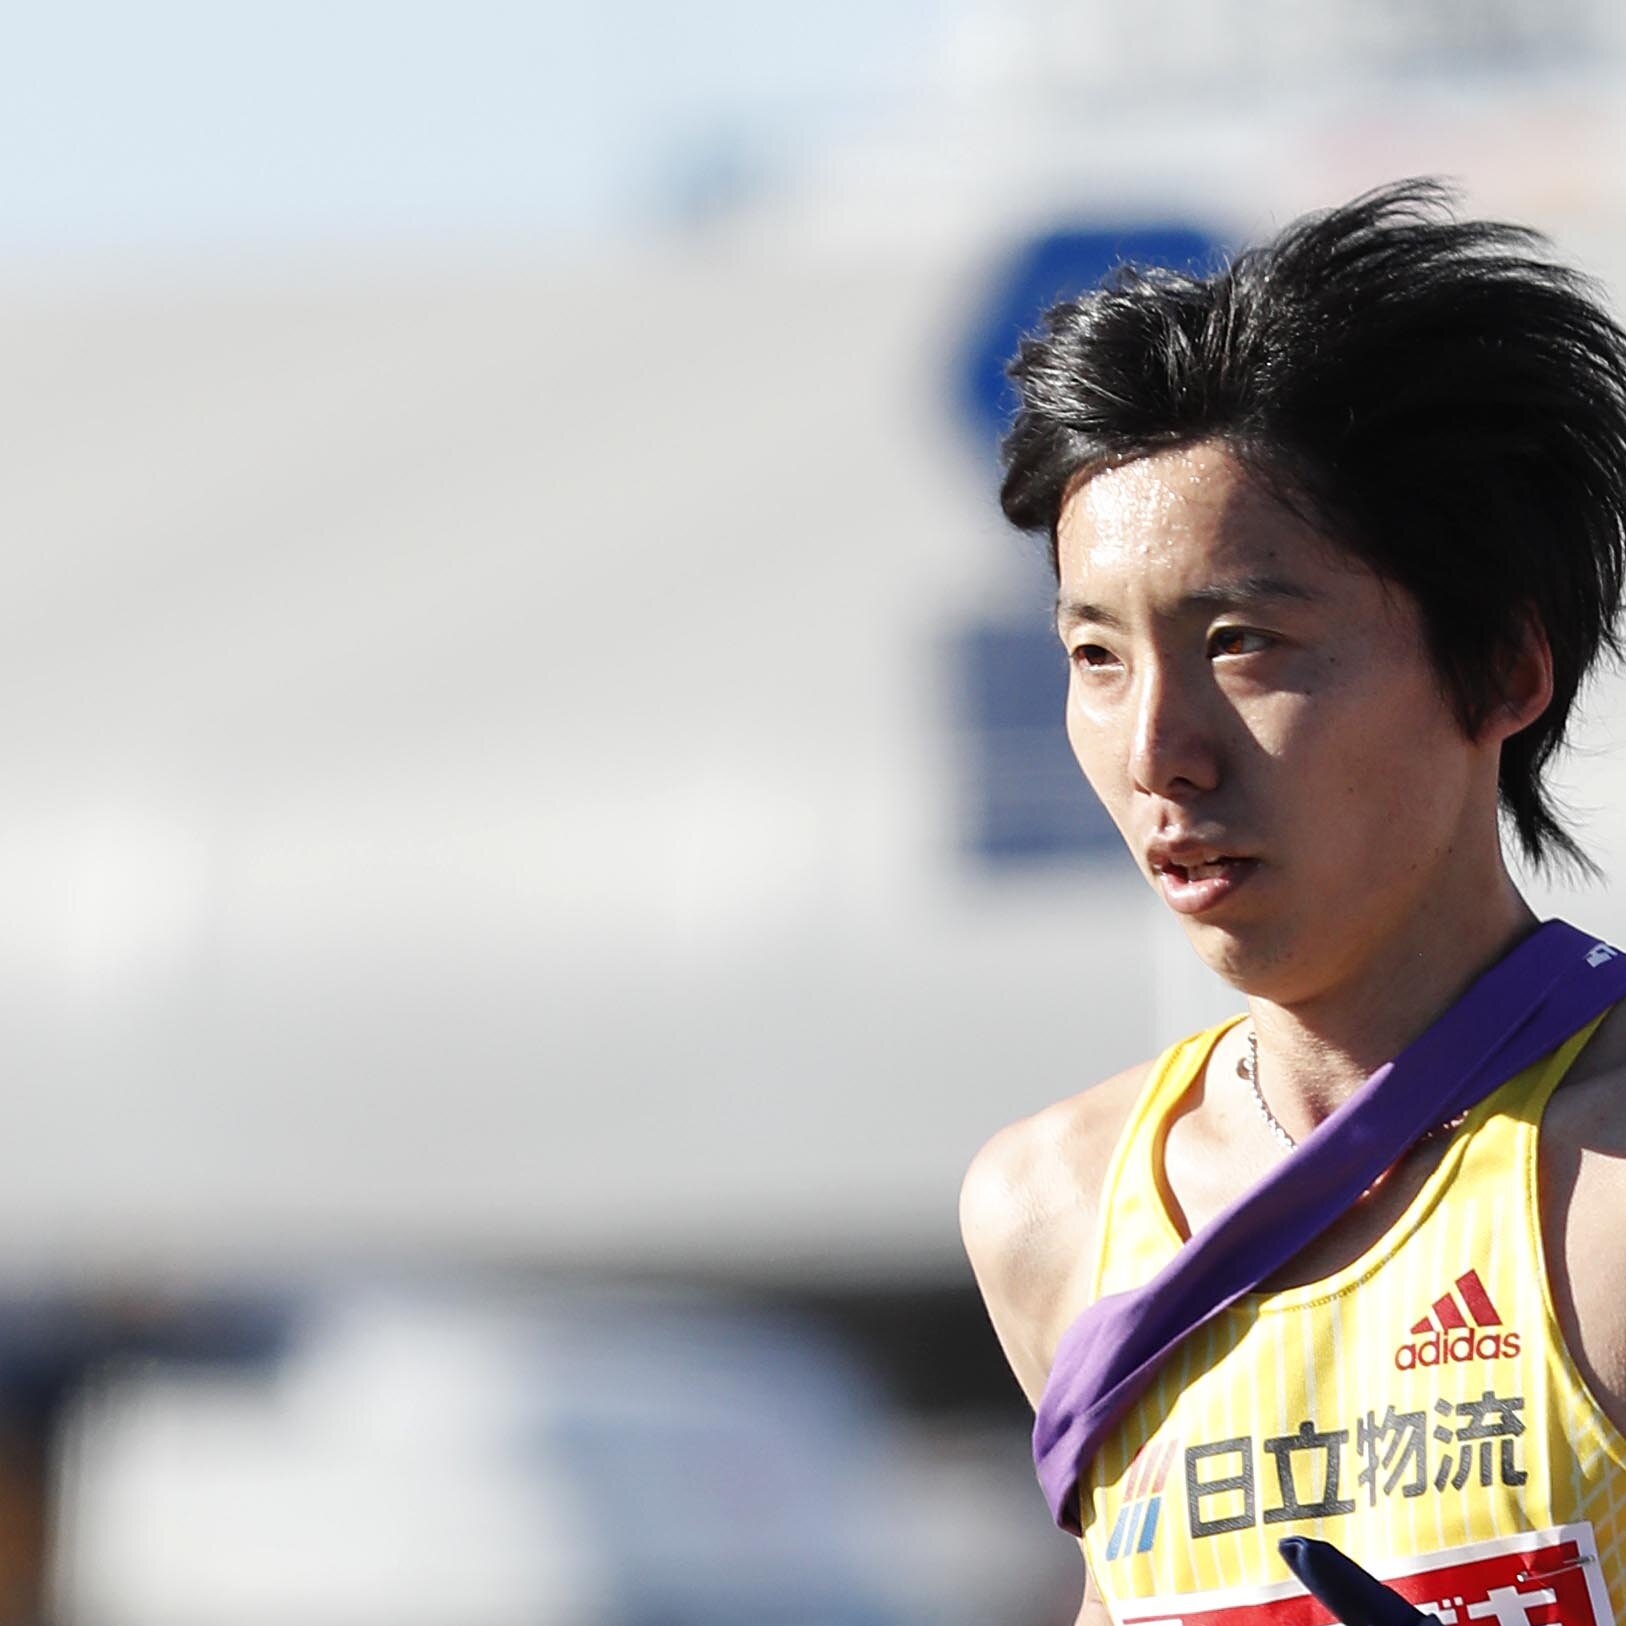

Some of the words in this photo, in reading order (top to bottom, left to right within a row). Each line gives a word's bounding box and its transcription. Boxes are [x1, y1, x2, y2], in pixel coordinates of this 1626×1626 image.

[1395, 1328, 1521, 1371] adidas
[1185, 1391, 1528, 1539] 日立物流
